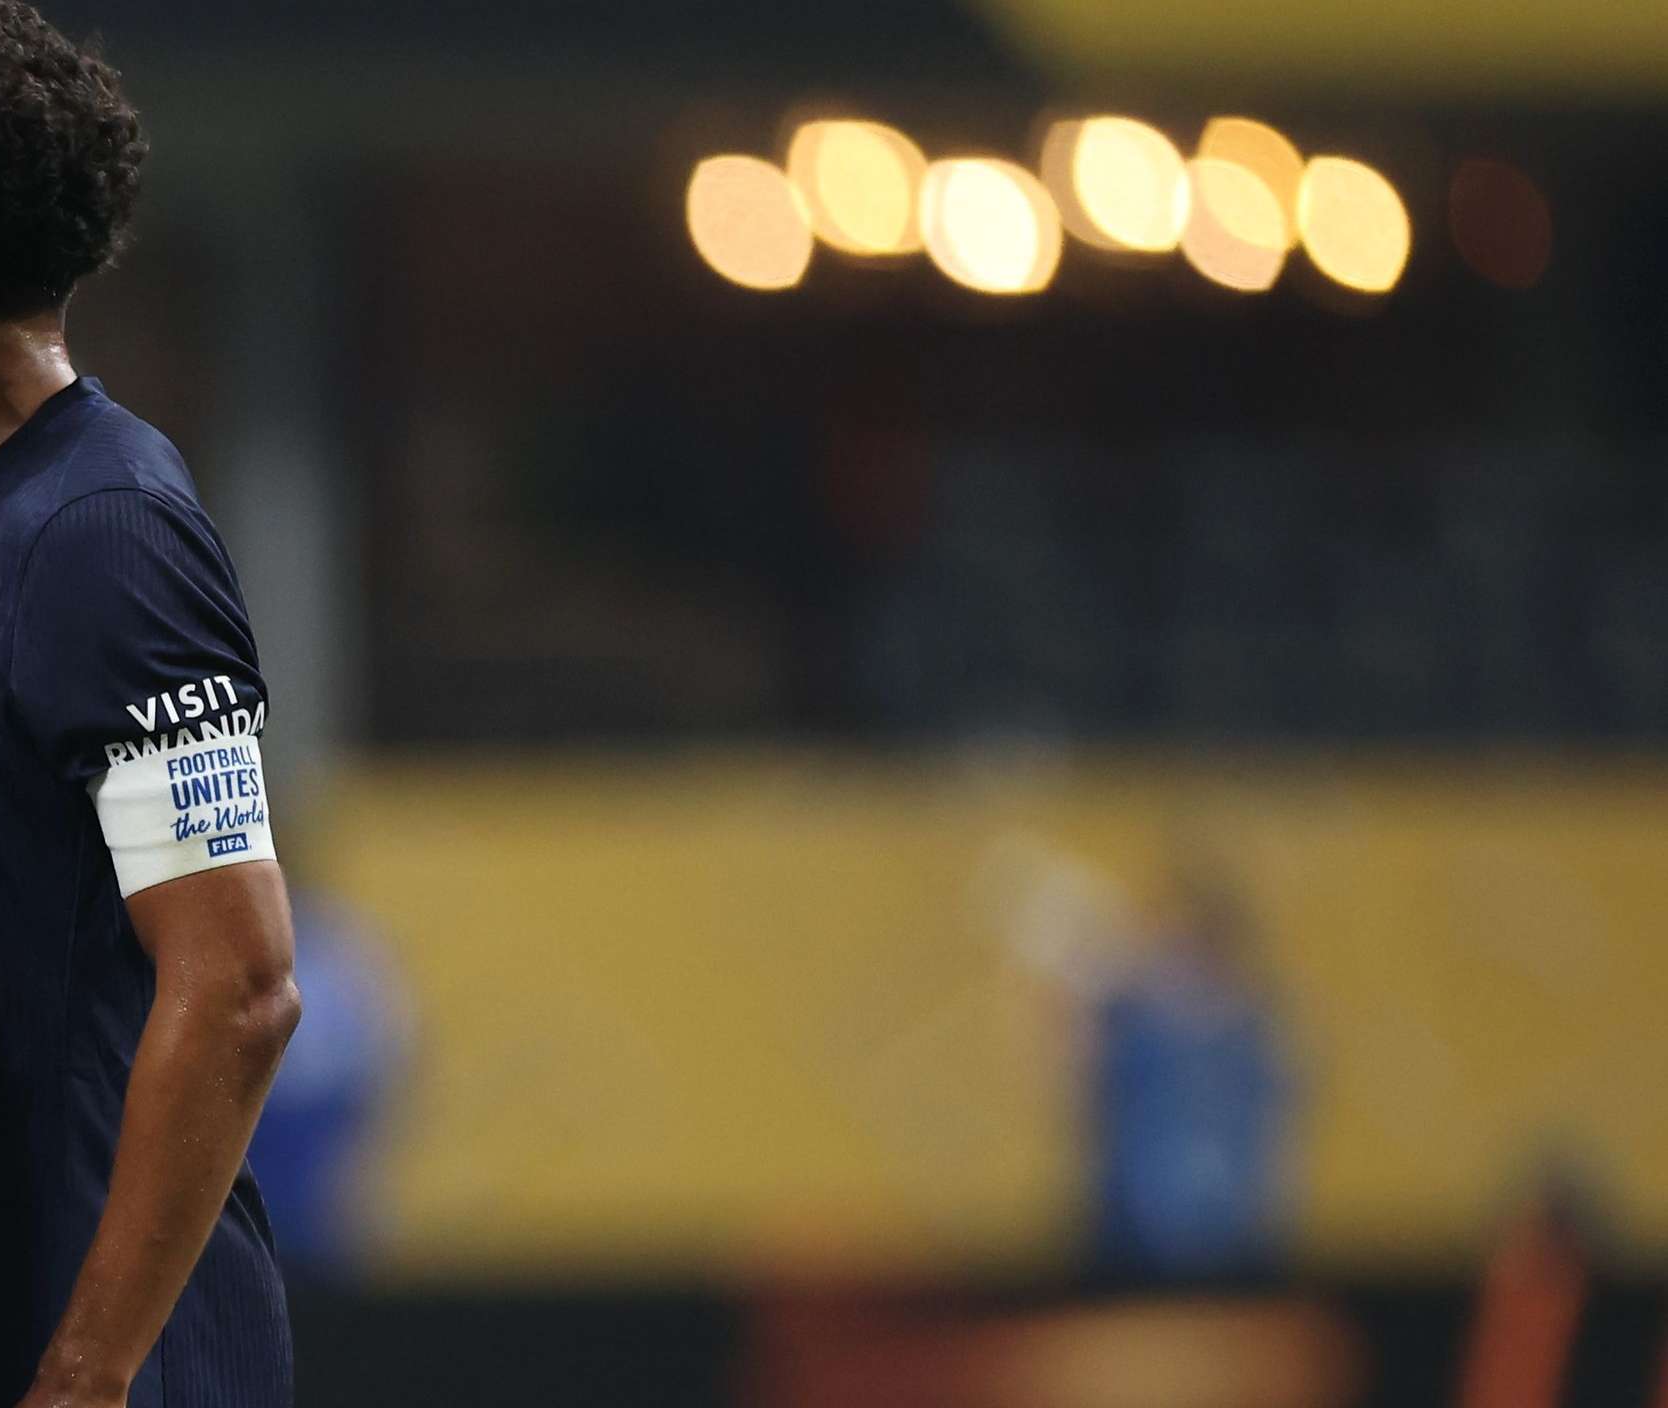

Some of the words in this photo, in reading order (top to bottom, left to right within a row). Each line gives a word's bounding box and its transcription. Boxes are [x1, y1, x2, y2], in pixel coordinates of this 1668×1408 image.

[126, 675, 239, 733] VISIT
[167, 744, 257, 780] FOOTBALL
[171, 768, 260, 811] UNITES
[170, 812, 211, 842] the
[214, 800, 265, 831] World
[211, 836, 247, 855] FIFA
